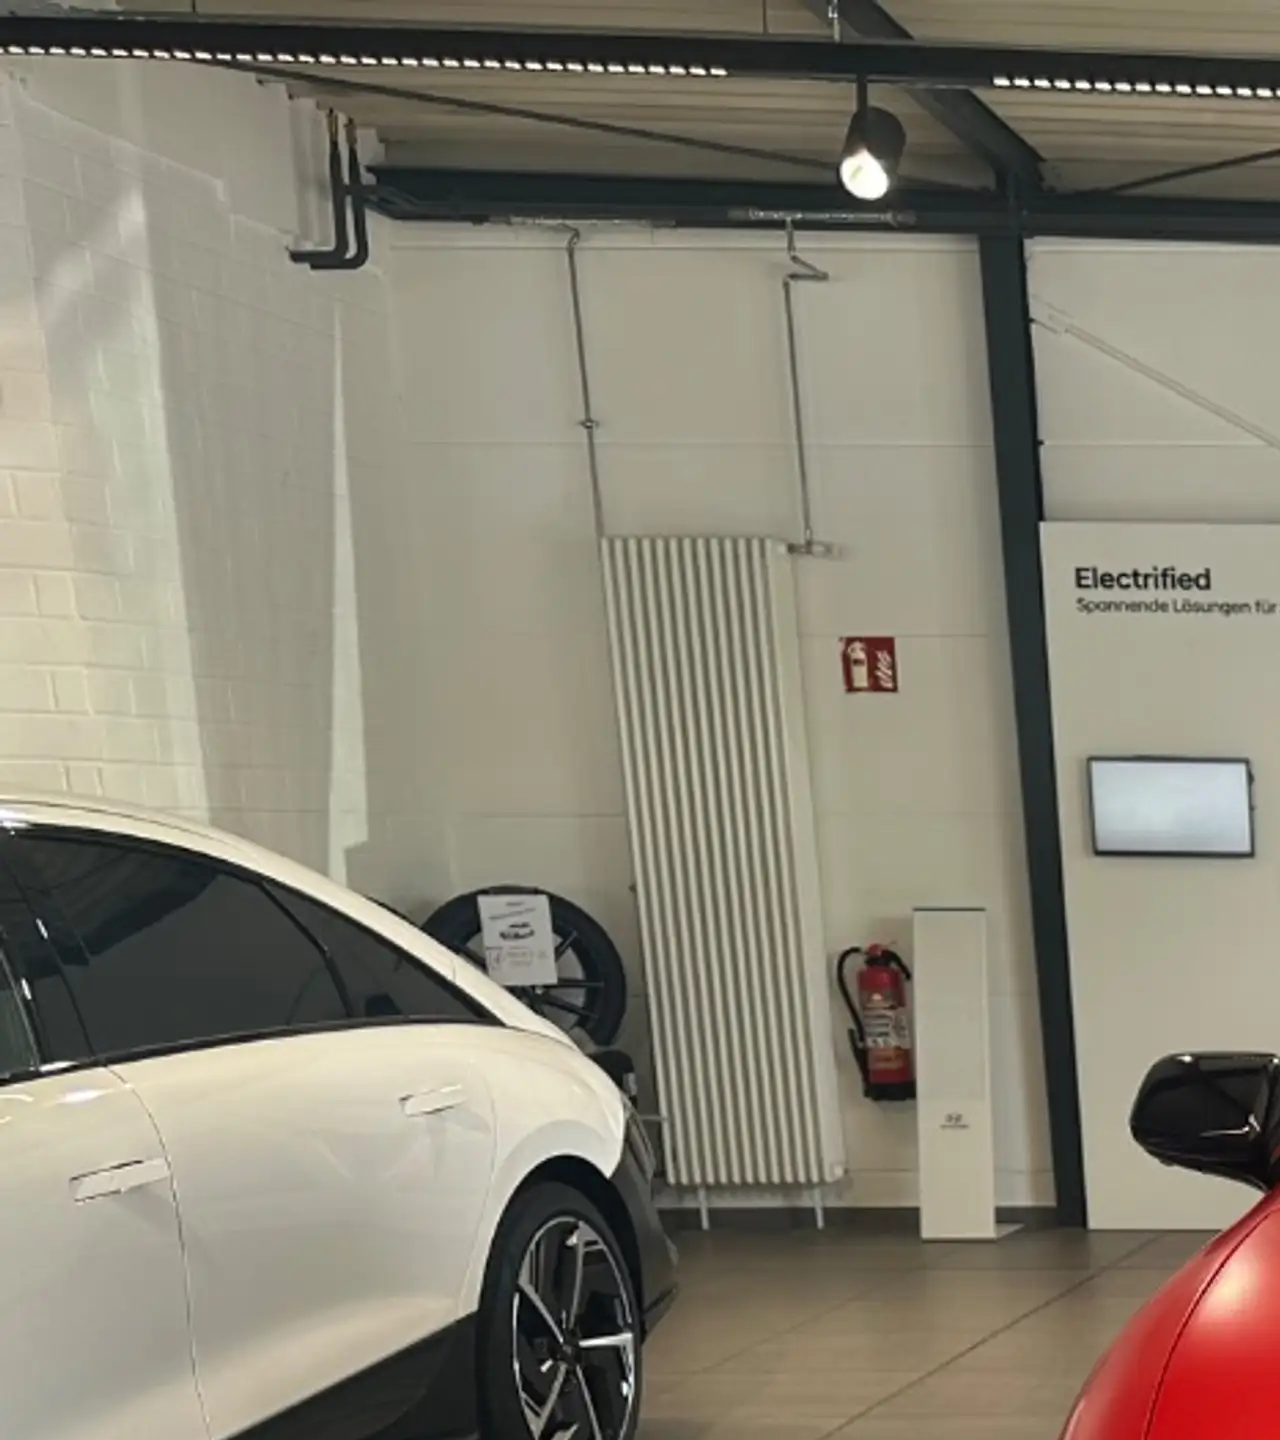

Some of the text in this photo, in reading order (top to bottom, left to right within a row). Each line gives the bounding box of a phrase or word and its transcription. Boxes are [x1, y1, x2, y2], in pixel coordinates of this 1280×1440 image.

[1074, 565, 1212, 590] Electrified
[1075, 597, 1169, 615] Spannende
[1172, 597, 1252, 618] Lösungen
[1254, 599, 1277, 614] für
